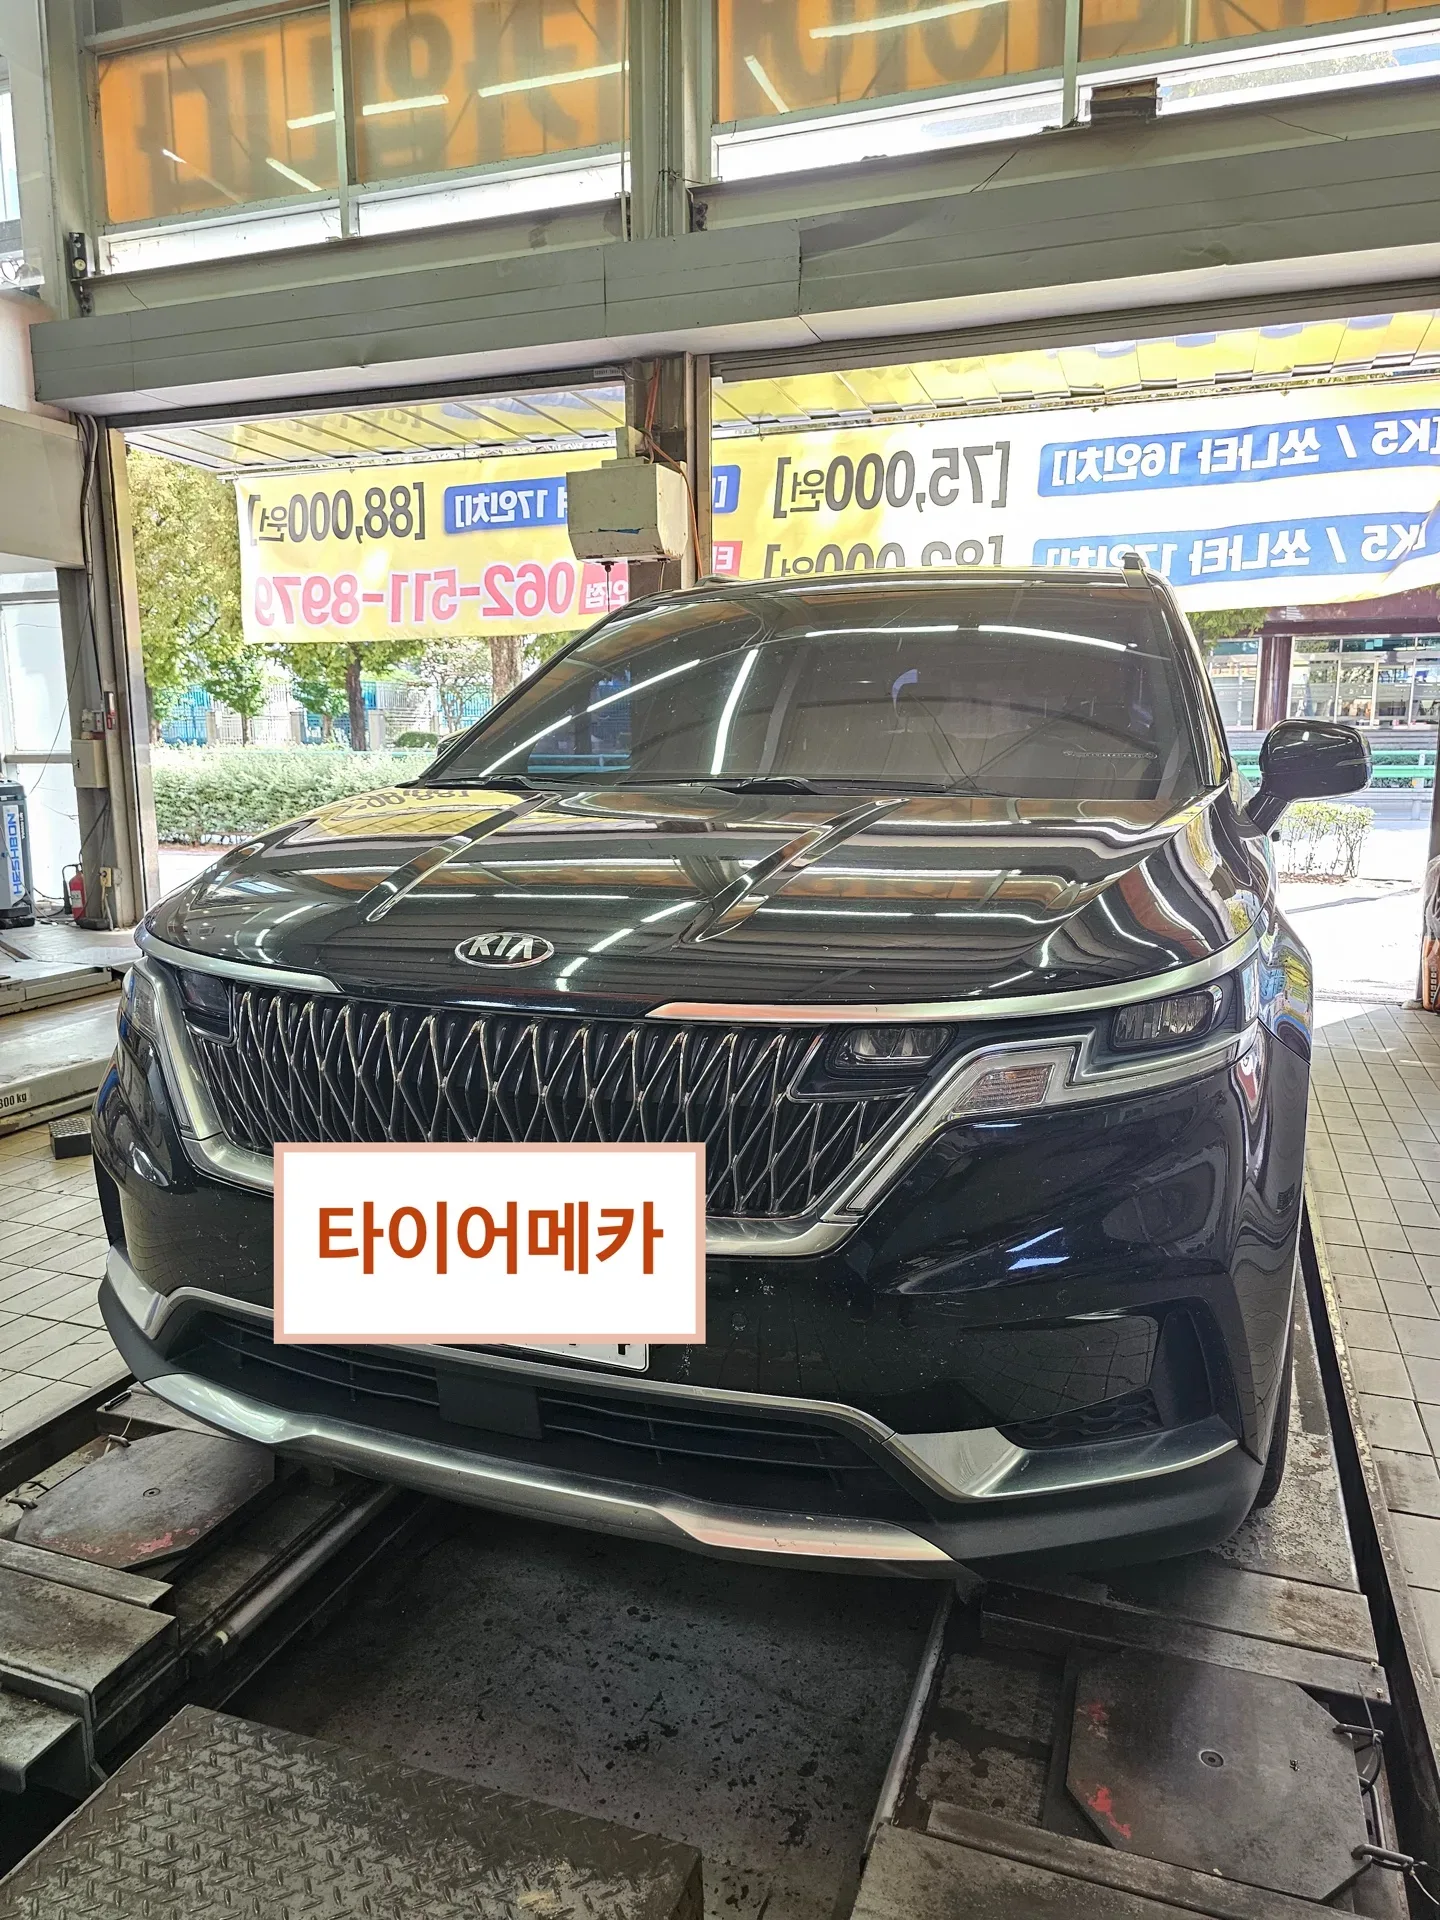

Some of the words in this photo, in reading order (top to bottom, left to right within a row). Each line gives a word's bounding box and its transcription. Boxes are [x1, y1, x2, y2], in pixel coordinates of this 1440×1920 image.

[7, 813, 22, 895] HESHBON
[469, 934, 534, 960] KIA
[17, 1093, 27, 1103] kg
